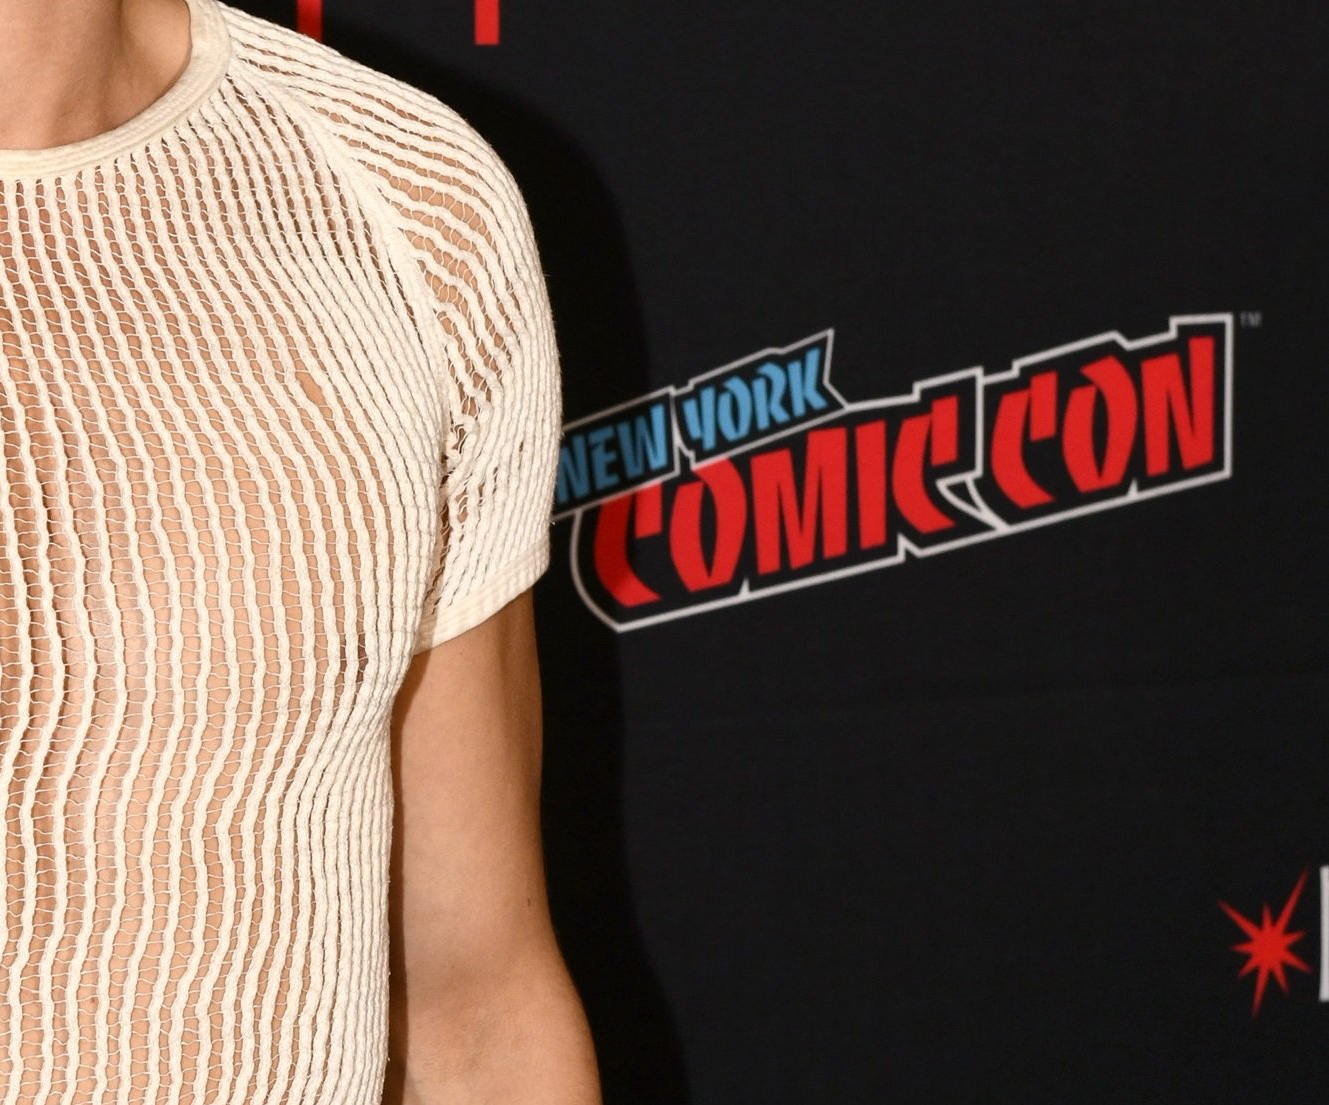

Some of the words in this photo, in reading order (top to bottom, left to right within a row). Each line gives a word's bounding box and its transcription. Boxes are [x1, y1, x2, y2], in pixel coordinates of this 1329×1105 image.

[556, 403, 669, 505] NEW
[682, 347, 828, 451] YORK
[593, 394, 960, 608] COMIC
[989, 335, 1216, 509] CON
